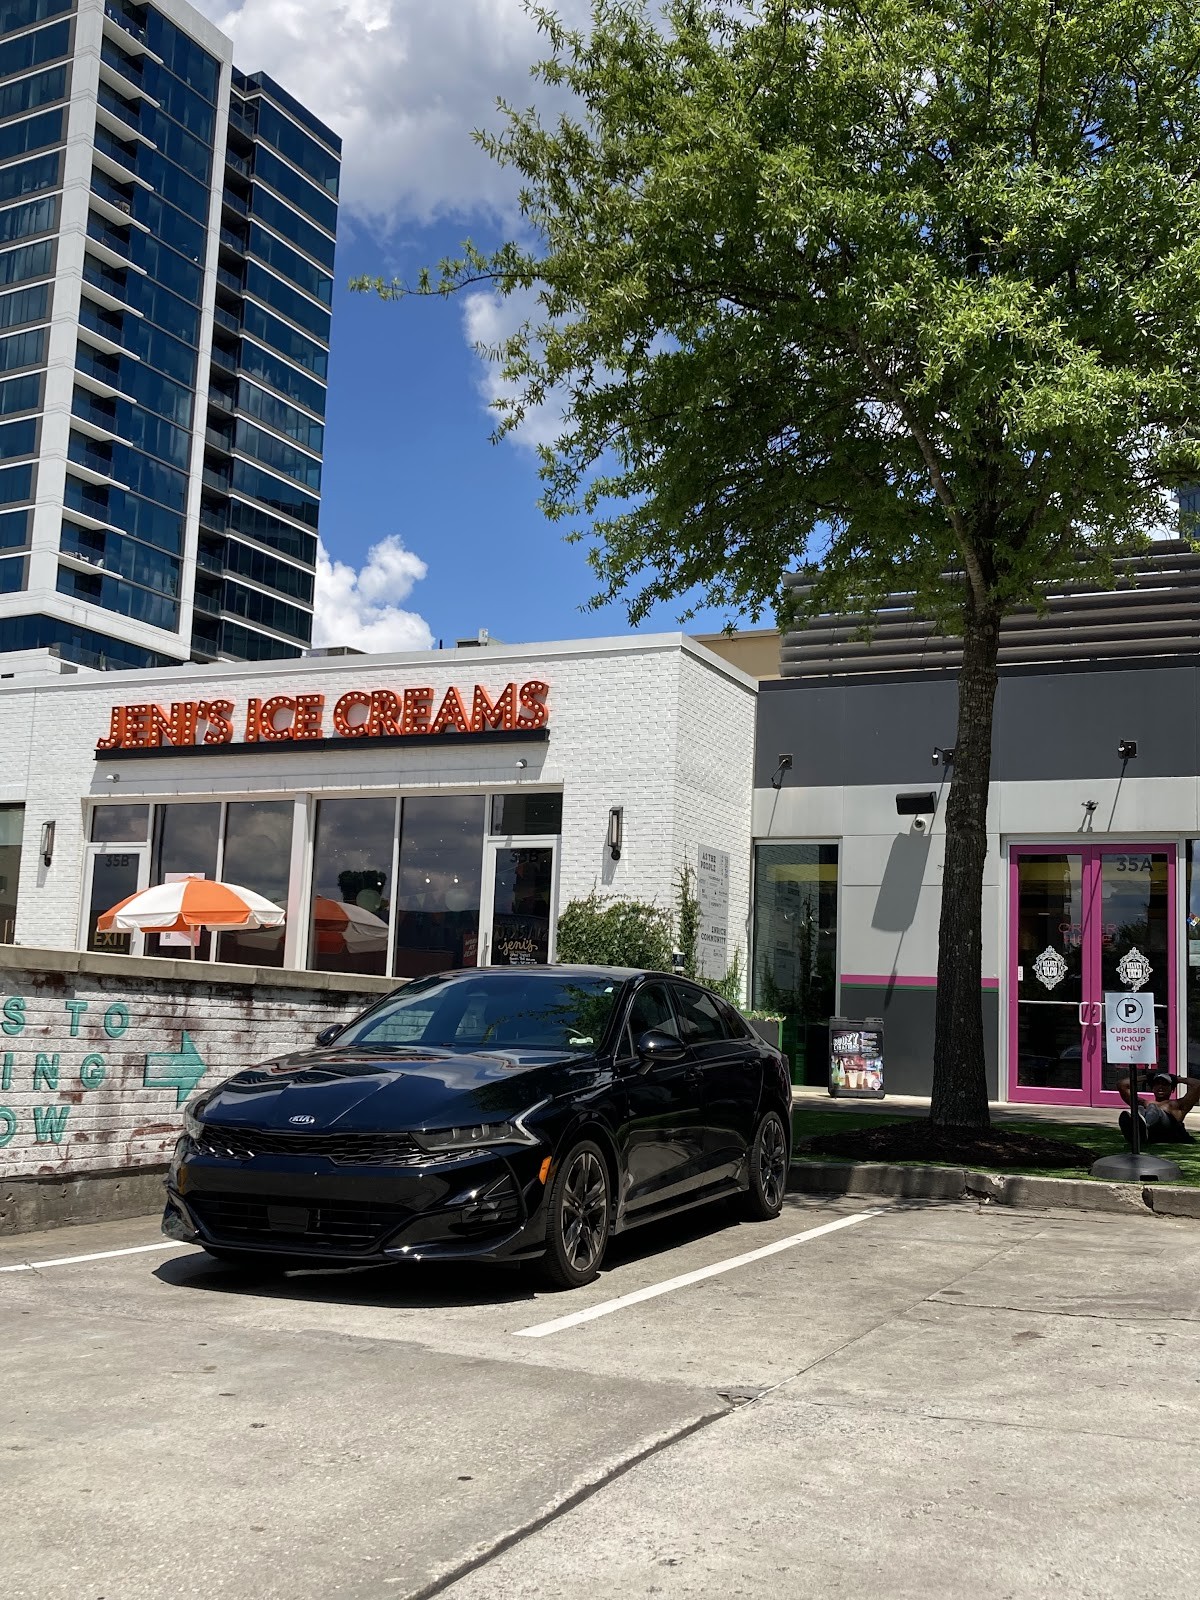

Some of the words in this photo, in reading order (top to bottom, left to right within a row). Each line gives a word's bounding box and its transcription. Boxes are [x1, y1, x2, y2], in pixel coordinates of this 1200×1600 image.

[96, 698, 234, 749] JENI'S
[244, 693, 326, 742] ICE
[332, 680, 551, 738] CREAMS
[105, 854, 130, 867] 35B
[1116, 857, 1154, 872] 35A
[94, 931, 125, 946] EXIT
[498, 937, 539, 956] jeni's
[1042, 966, 1058, 976] TACO
[1126, 968, 1142, 979] TACO
[1, 996, 27, 1036] S
[65, 1000, 130, 1038] TO
[1124, 1003, 1137, 1018] P
[1, 1052, 106, 1091] ING
[0, 1105, 71, 1147] OW
